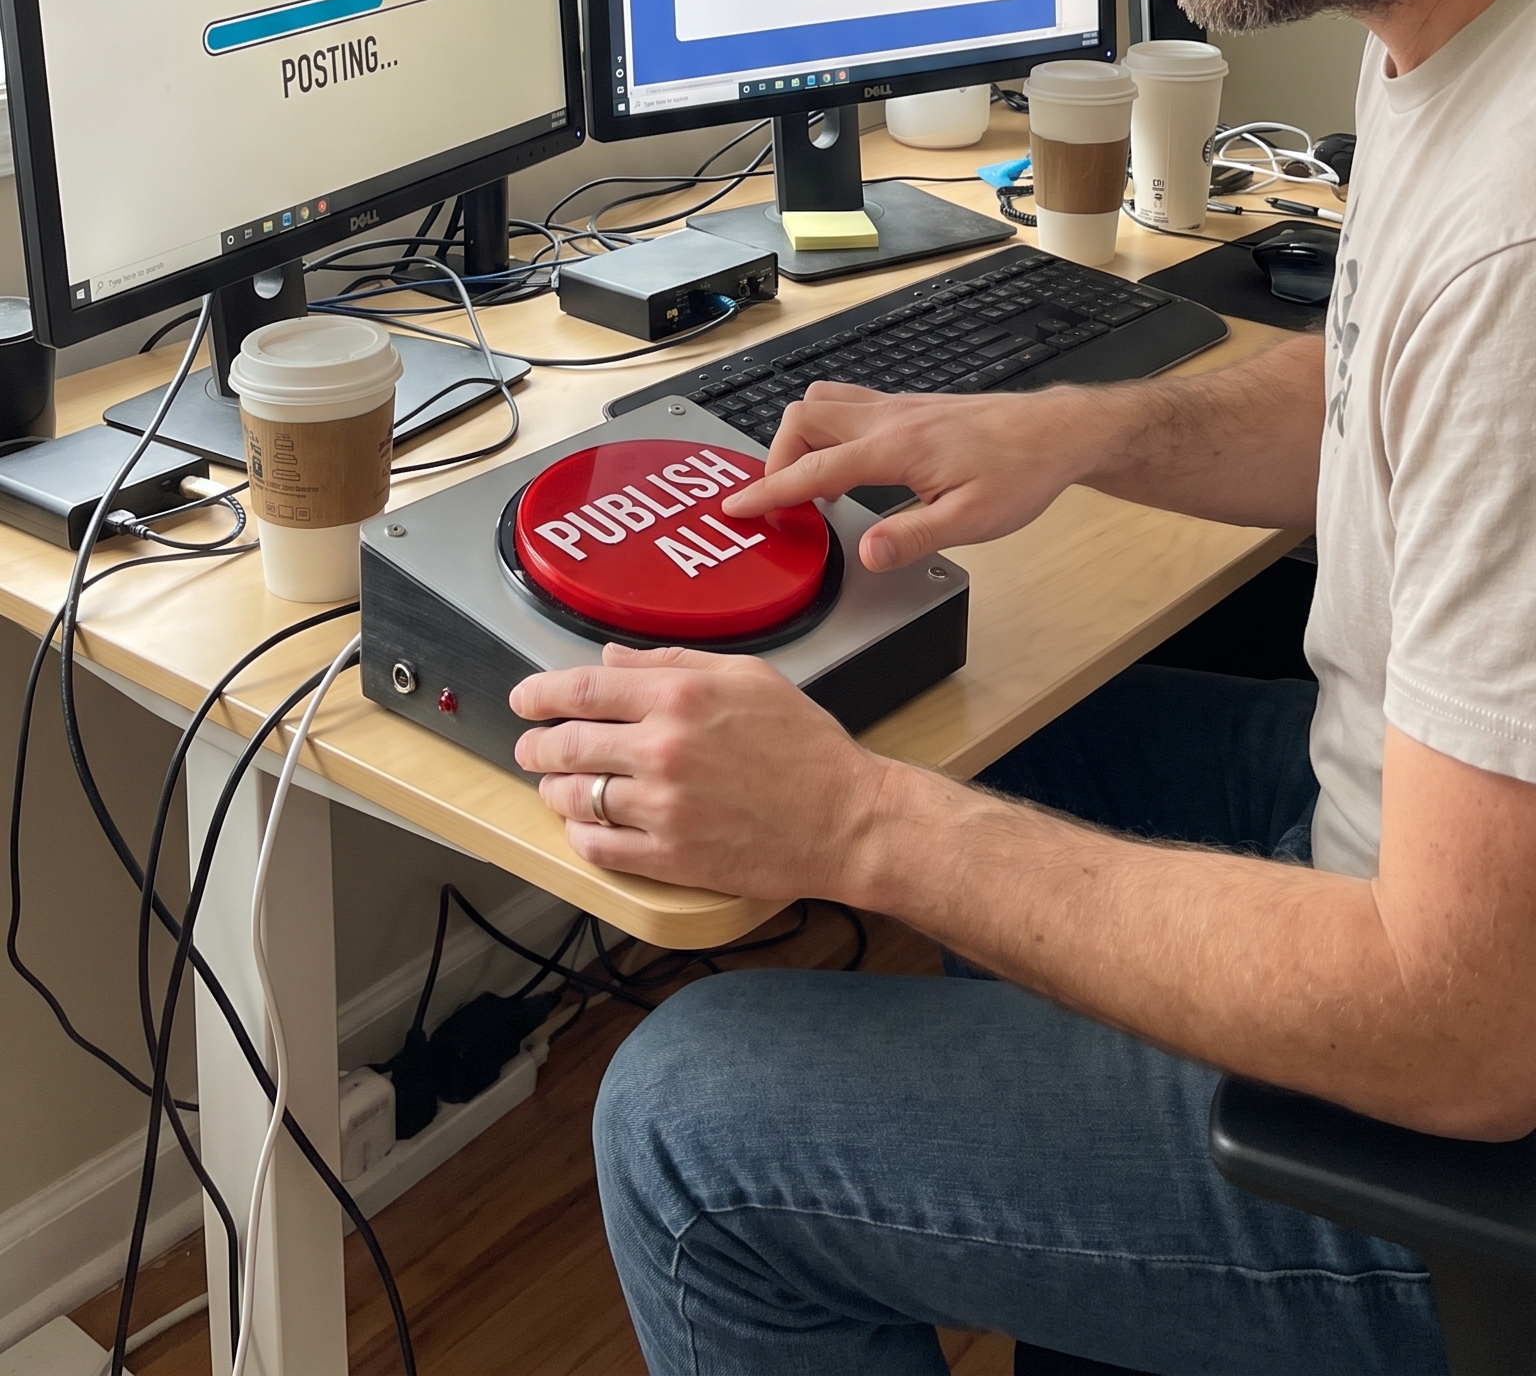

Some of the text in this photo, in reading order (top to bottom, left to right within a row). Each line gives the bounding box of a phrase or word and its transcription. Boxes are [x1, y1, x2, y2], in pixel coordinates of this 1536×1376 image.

[281, 35, 398, 99] POSTING...
[864, 84, 893, 99] DELL
[350, 209, 380, 232] DELL
[533, 449, 751, 562] PUBLISH
[653, 514, 766, 578] ALL
